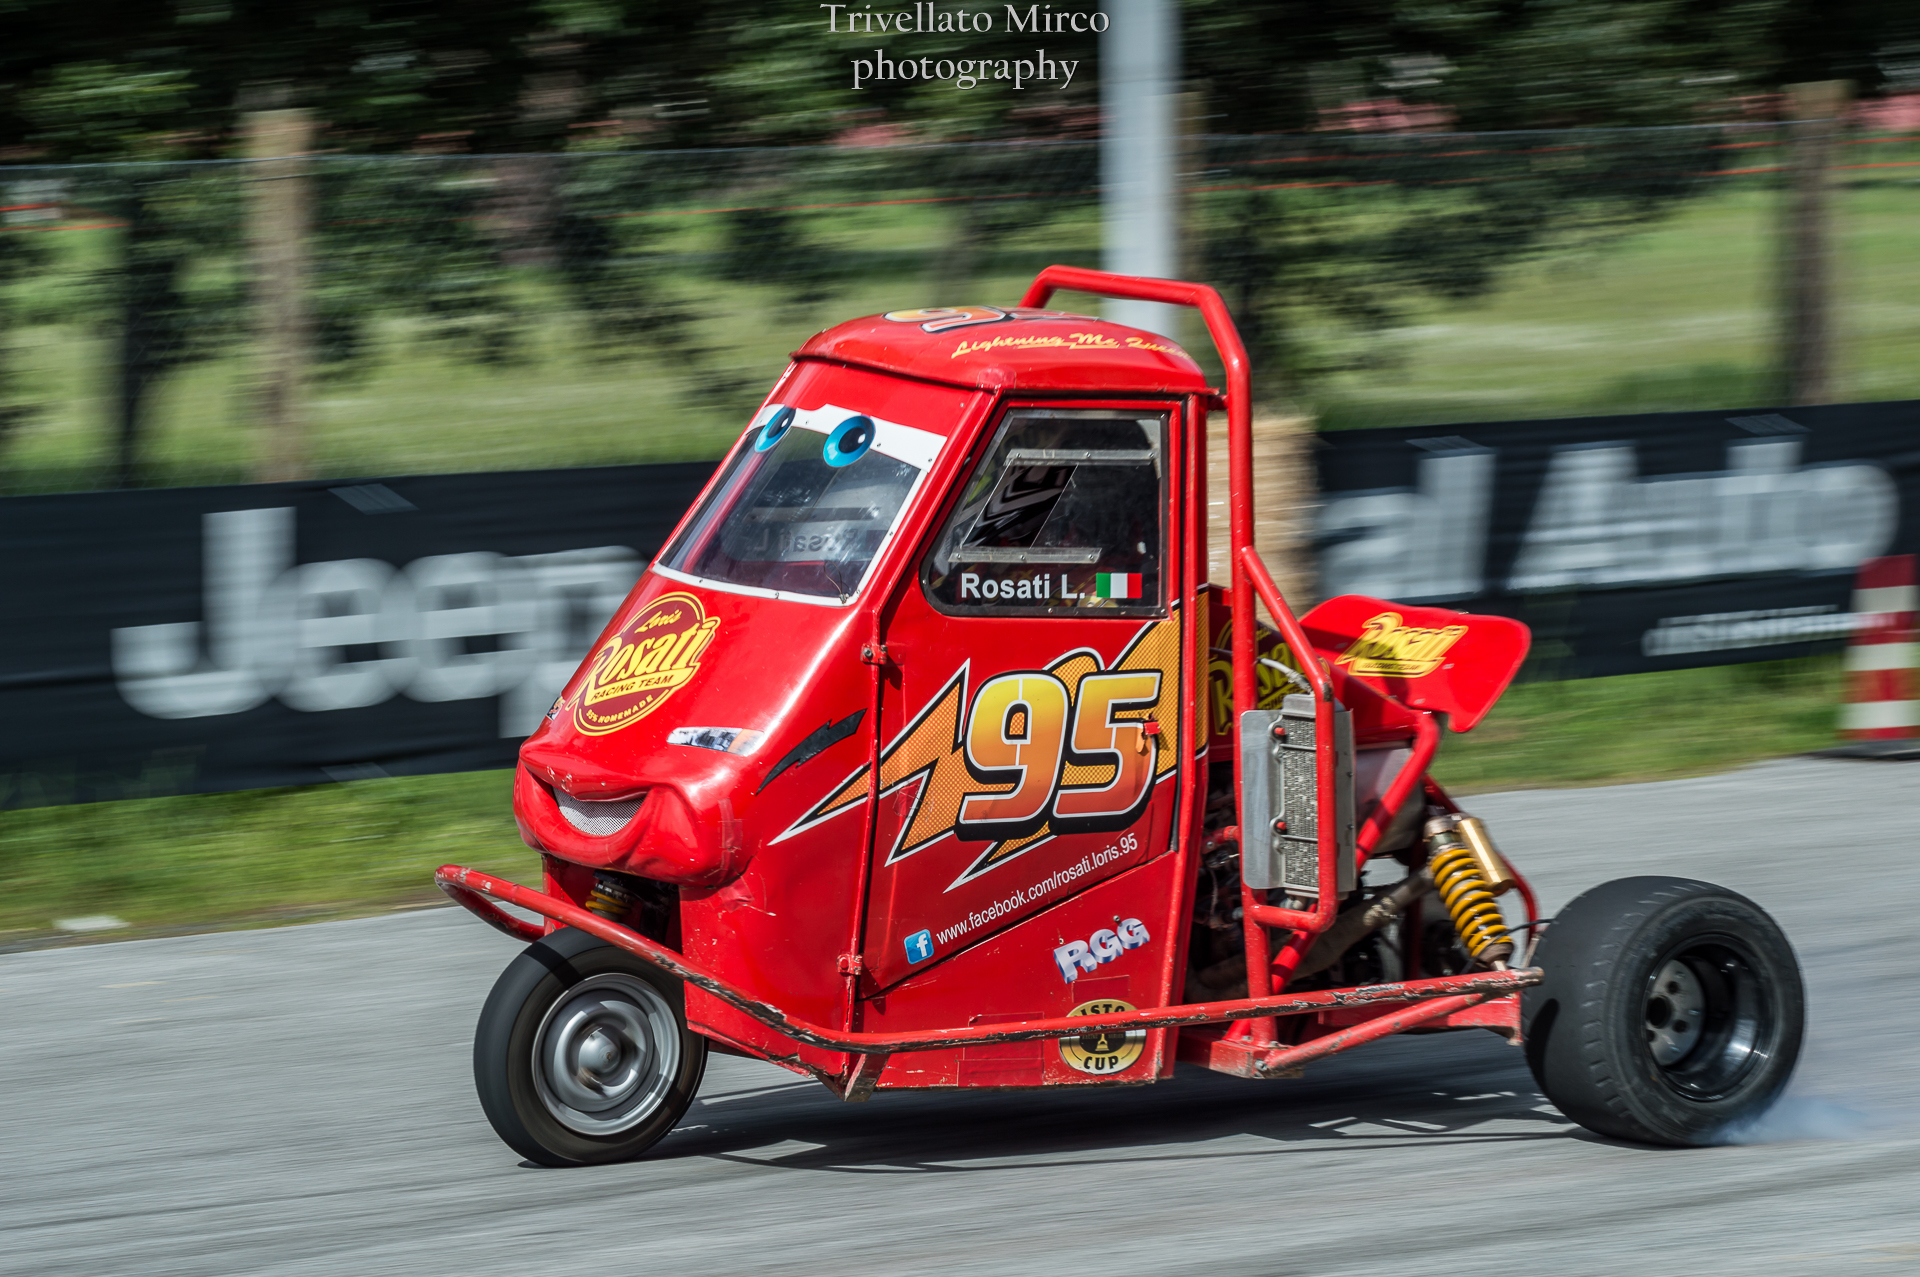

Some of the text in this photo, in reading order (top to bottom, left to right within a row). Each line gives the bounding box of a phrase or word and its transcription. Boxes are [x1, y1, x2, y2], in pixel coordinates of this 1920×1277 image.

[951, 336, 1065, 359] Lightning
[961, 572, 1086, 599] Rosati L.
[584, 621, 716, 706] Rosati
[591, 674, 674, 701] RACING TEAM
[598, 694, 653, 723] HOMEMADE
[955, 672, 1162, 826] 95
[936, 832, 1138, 945] www.facebook.com/rosati.loris.95
[1053, 918, 1150, 985] RGG
[1084, 1055, 1119, 1071] CUP
